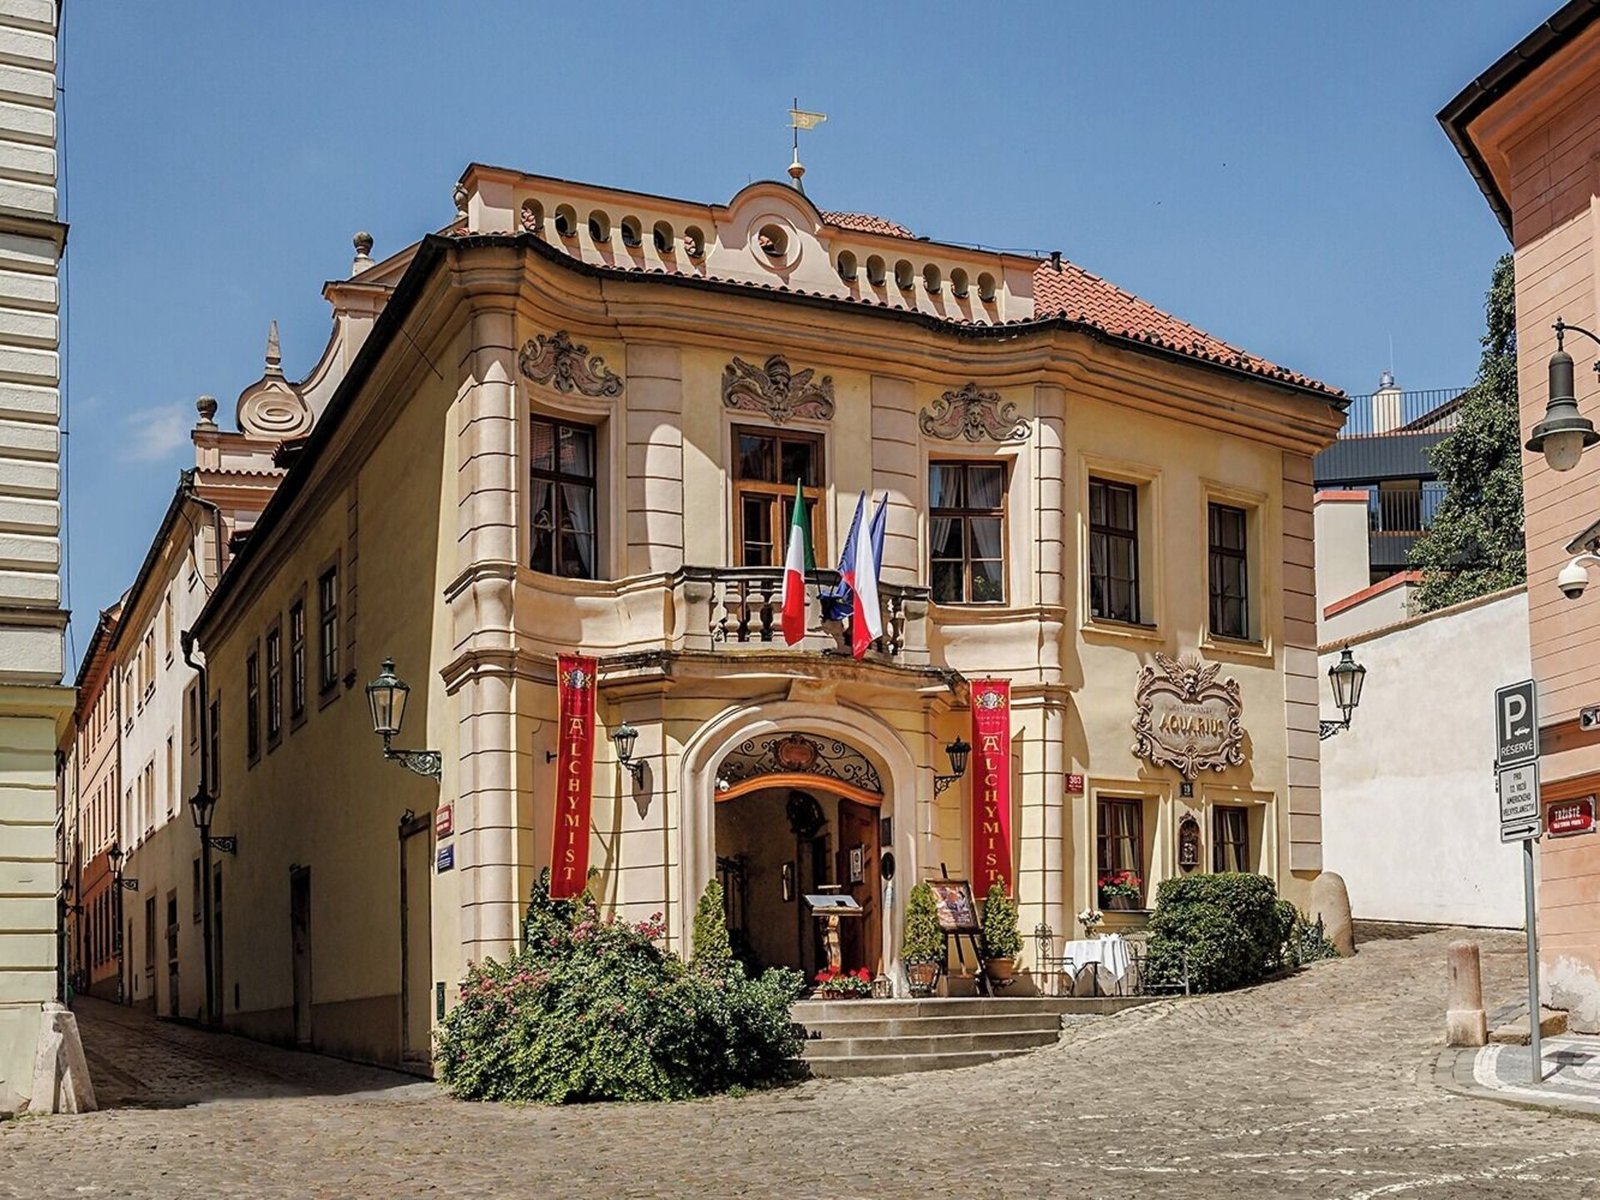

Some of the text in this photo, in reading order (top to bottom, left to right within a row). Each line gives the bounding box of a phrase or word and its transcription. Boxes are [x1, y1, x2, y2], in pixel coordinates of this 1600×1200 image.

[1159, 713, 1224, 735] AQUARIUS
[1504, 694, 1526, 740] P
[564, 718, 584, 880] ALCHYMIST
[983, 736, 999, 881] ALCHYMIST
